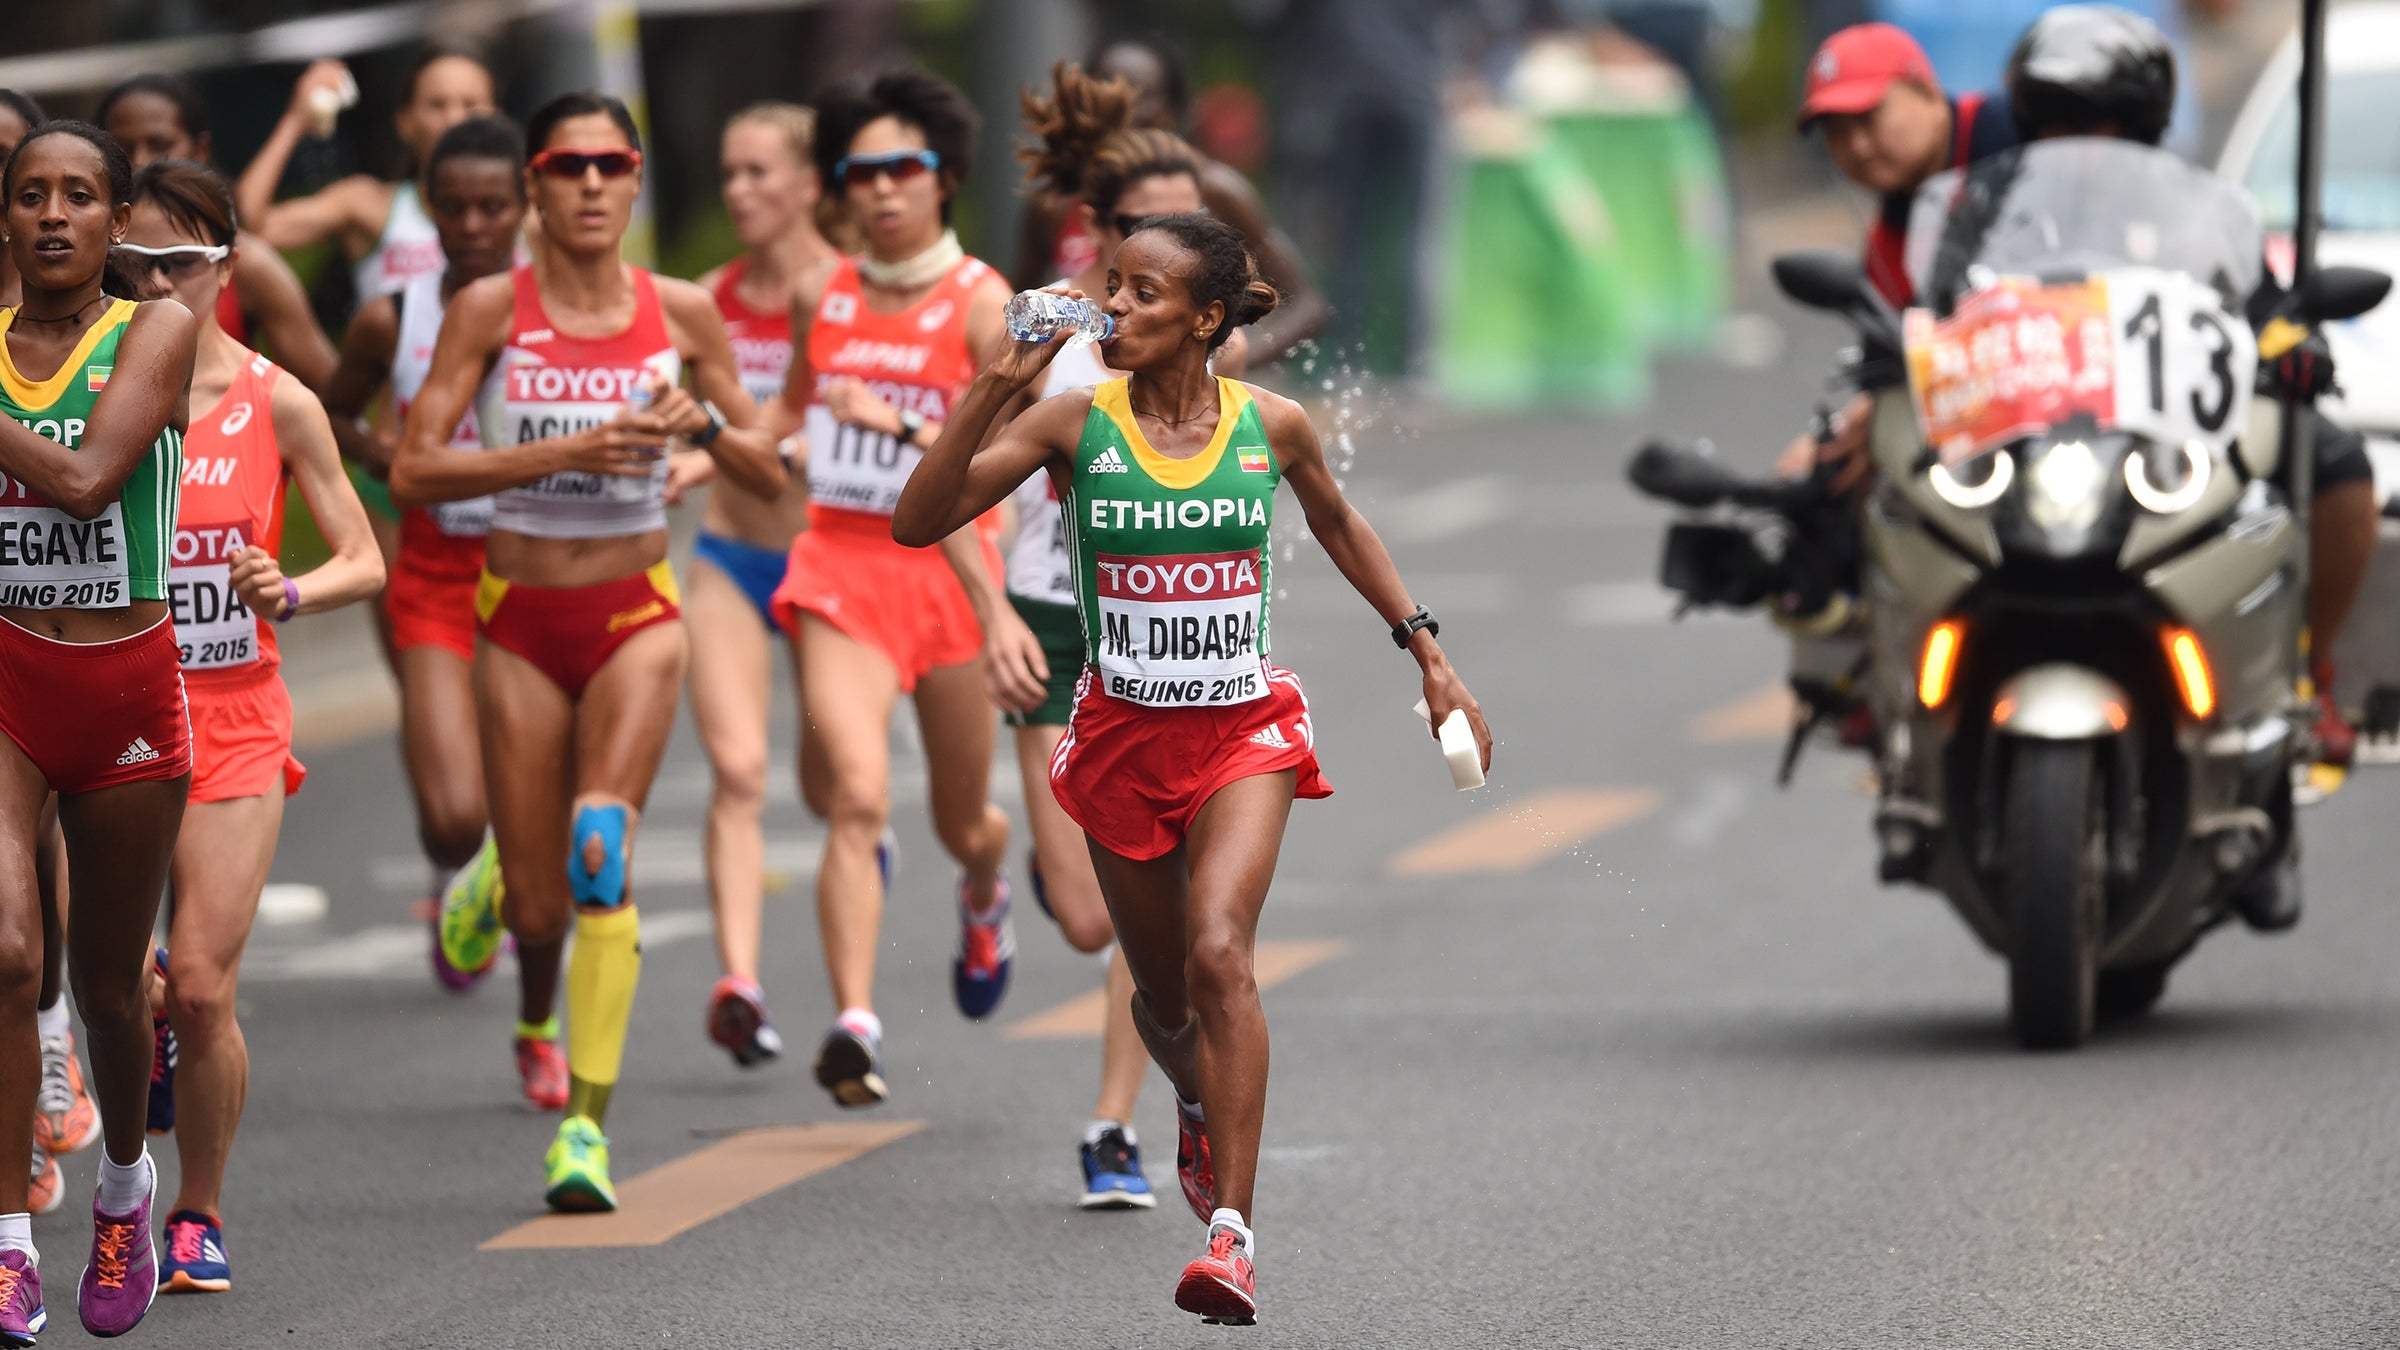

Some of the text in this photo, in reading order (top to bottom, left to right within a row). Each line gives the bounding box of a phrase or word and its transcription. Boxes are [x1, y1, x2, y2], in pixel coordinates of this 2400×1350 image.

[2126, 294, 2233, 432] 13
[1088, 462, 1129, 474] adidas
[1091, 498, 1267, 530] ETHIOPIA
[0, 518, 117, 566] EGAYE
[1103, 558, 1257, 595] TOYOTA
[62, 580, 121, 606] 2015
[168, 580, 248, 626] EDA
[199, 636, 248, 662] 2015
[1106, 611, 1251, 661] M. DIBABA
[1112, 673, 1256, 703] BEIJING 2015
[116, 748, 160, 766] adidas
